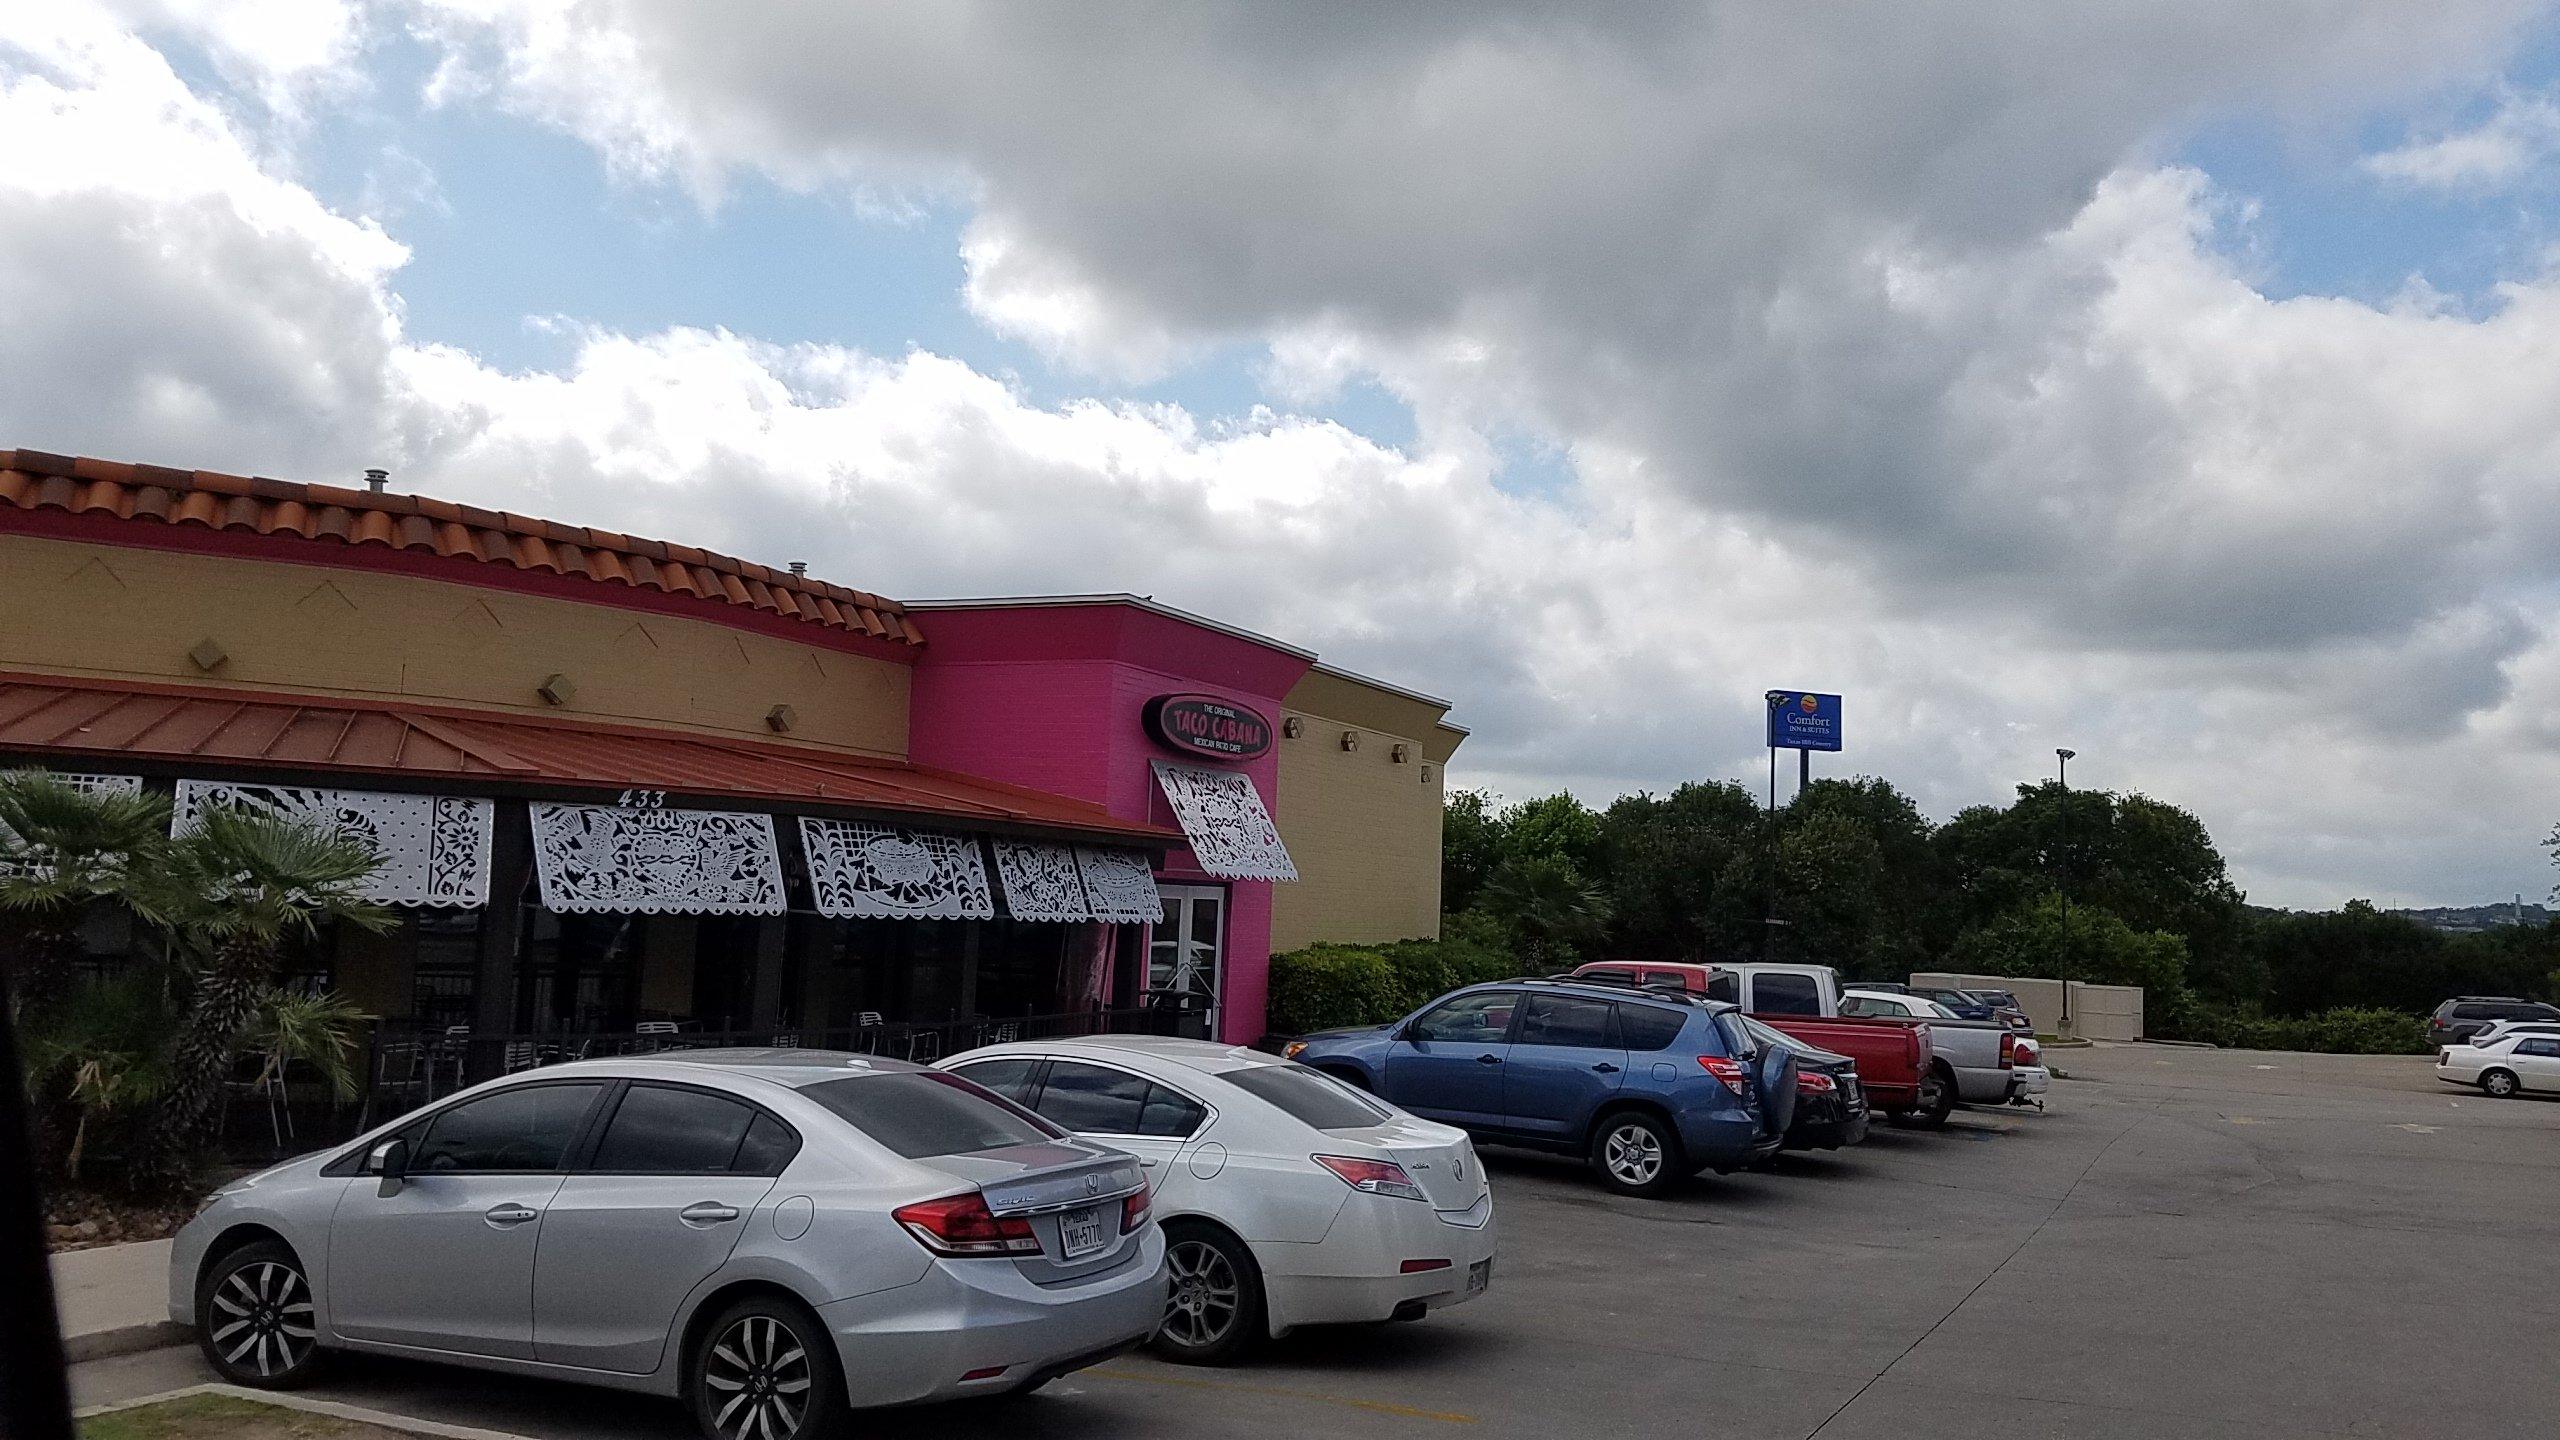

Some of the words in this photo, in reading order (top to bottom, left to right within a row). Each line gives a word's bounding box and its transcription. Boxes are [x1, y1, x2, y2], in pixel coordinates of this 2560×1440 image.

[1204, 704, 1213, 713] THE
[1214, 706, 1235, 719] ORIGINAL
[1787, 712, 1830, 726] Comfort
[1174, 709, 1208, 737] TACO
[1212, 717, 1262, 747] CABANA
[1193, 737, 1215, 749] MEXICAN
[1215, 740, 1229, 751] PATIO
[1229, 743, 1242, 753] CAFE
[618, 789, 666, 808] 433
